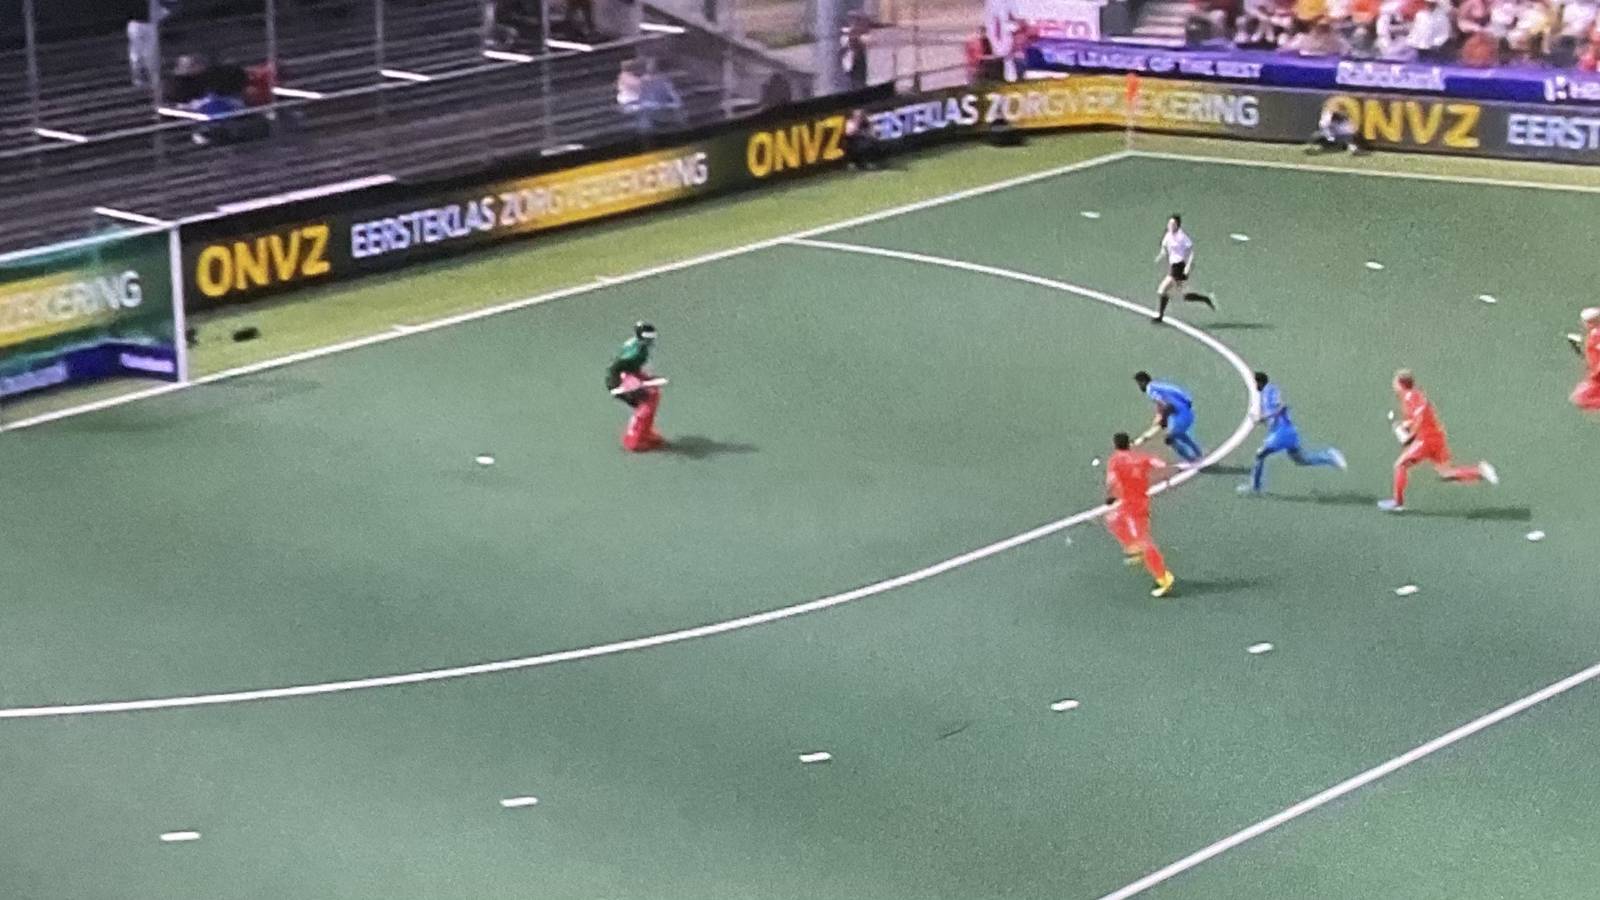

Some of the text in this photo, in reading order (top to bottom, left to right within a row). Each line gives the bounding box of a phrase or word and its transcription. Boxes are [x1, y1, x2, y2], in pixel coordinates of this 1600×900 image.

[746, 115, 845, 178] ONVZ
[195, 224, 331, 298] ONVZ
[350, 197, 497, 258] EERSTEKLAS
